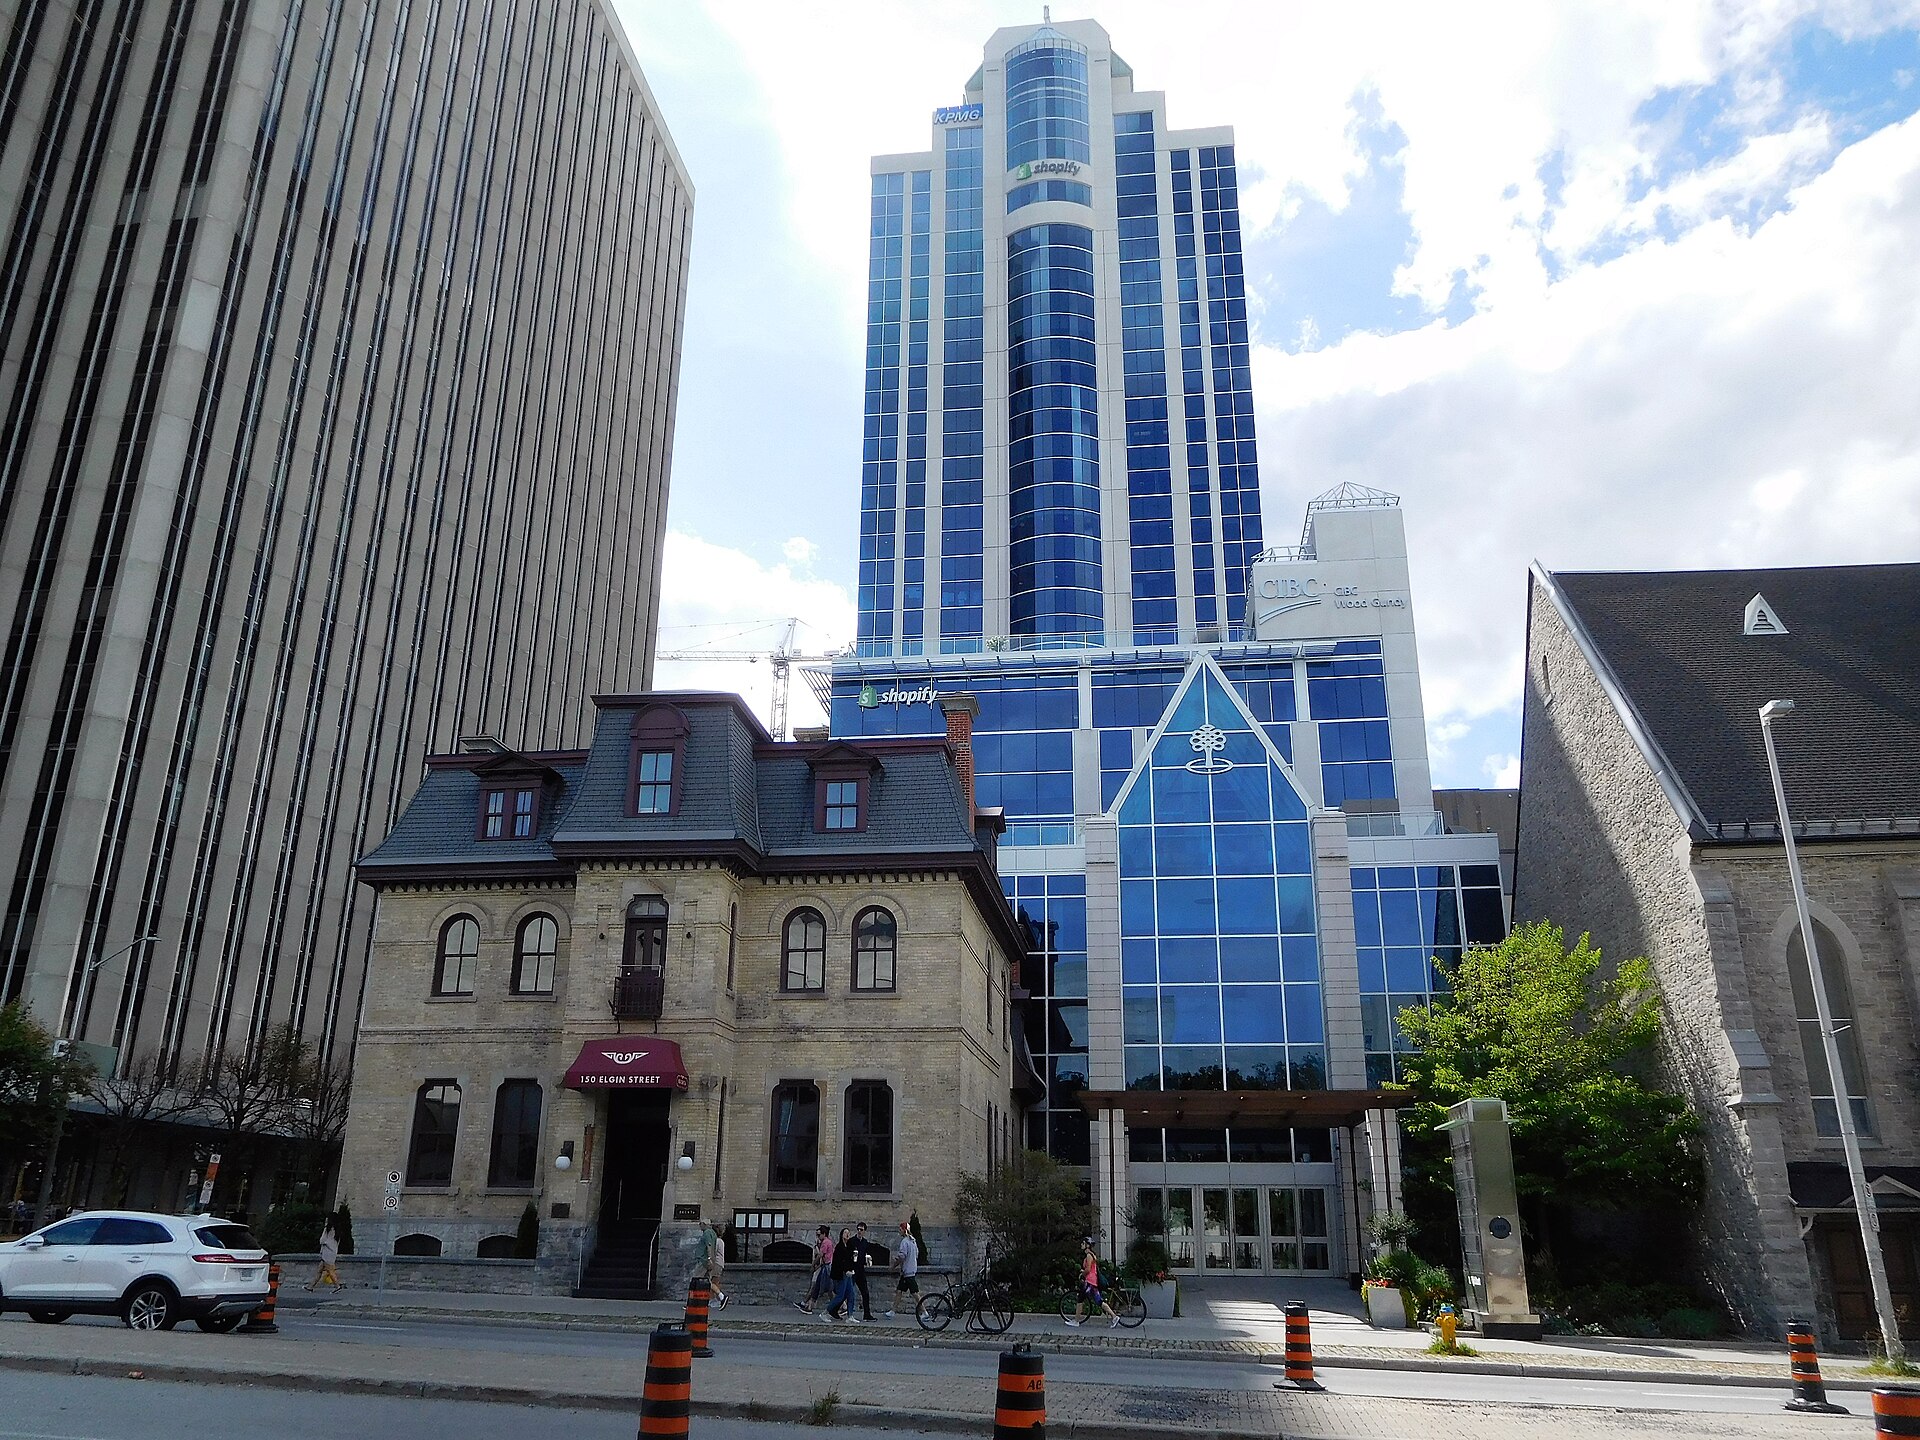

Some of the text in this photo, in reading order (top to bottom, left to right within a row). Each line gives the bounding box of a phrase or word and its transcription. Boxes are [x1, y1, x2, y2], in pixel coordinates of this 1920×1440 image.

[934, 109, 980, 124] KPMG
[1033, 161, 1081, 176] shopify
[1259, 578, 1320, 599] CIBC
[1334, 586, 1358, 596] CIBC
[1335, 597, 1408, 610] Wood Gundy
[881, 686, 938, 706] shopify
[580, 1075, 660, 1084] 150 ELGIN STREET
